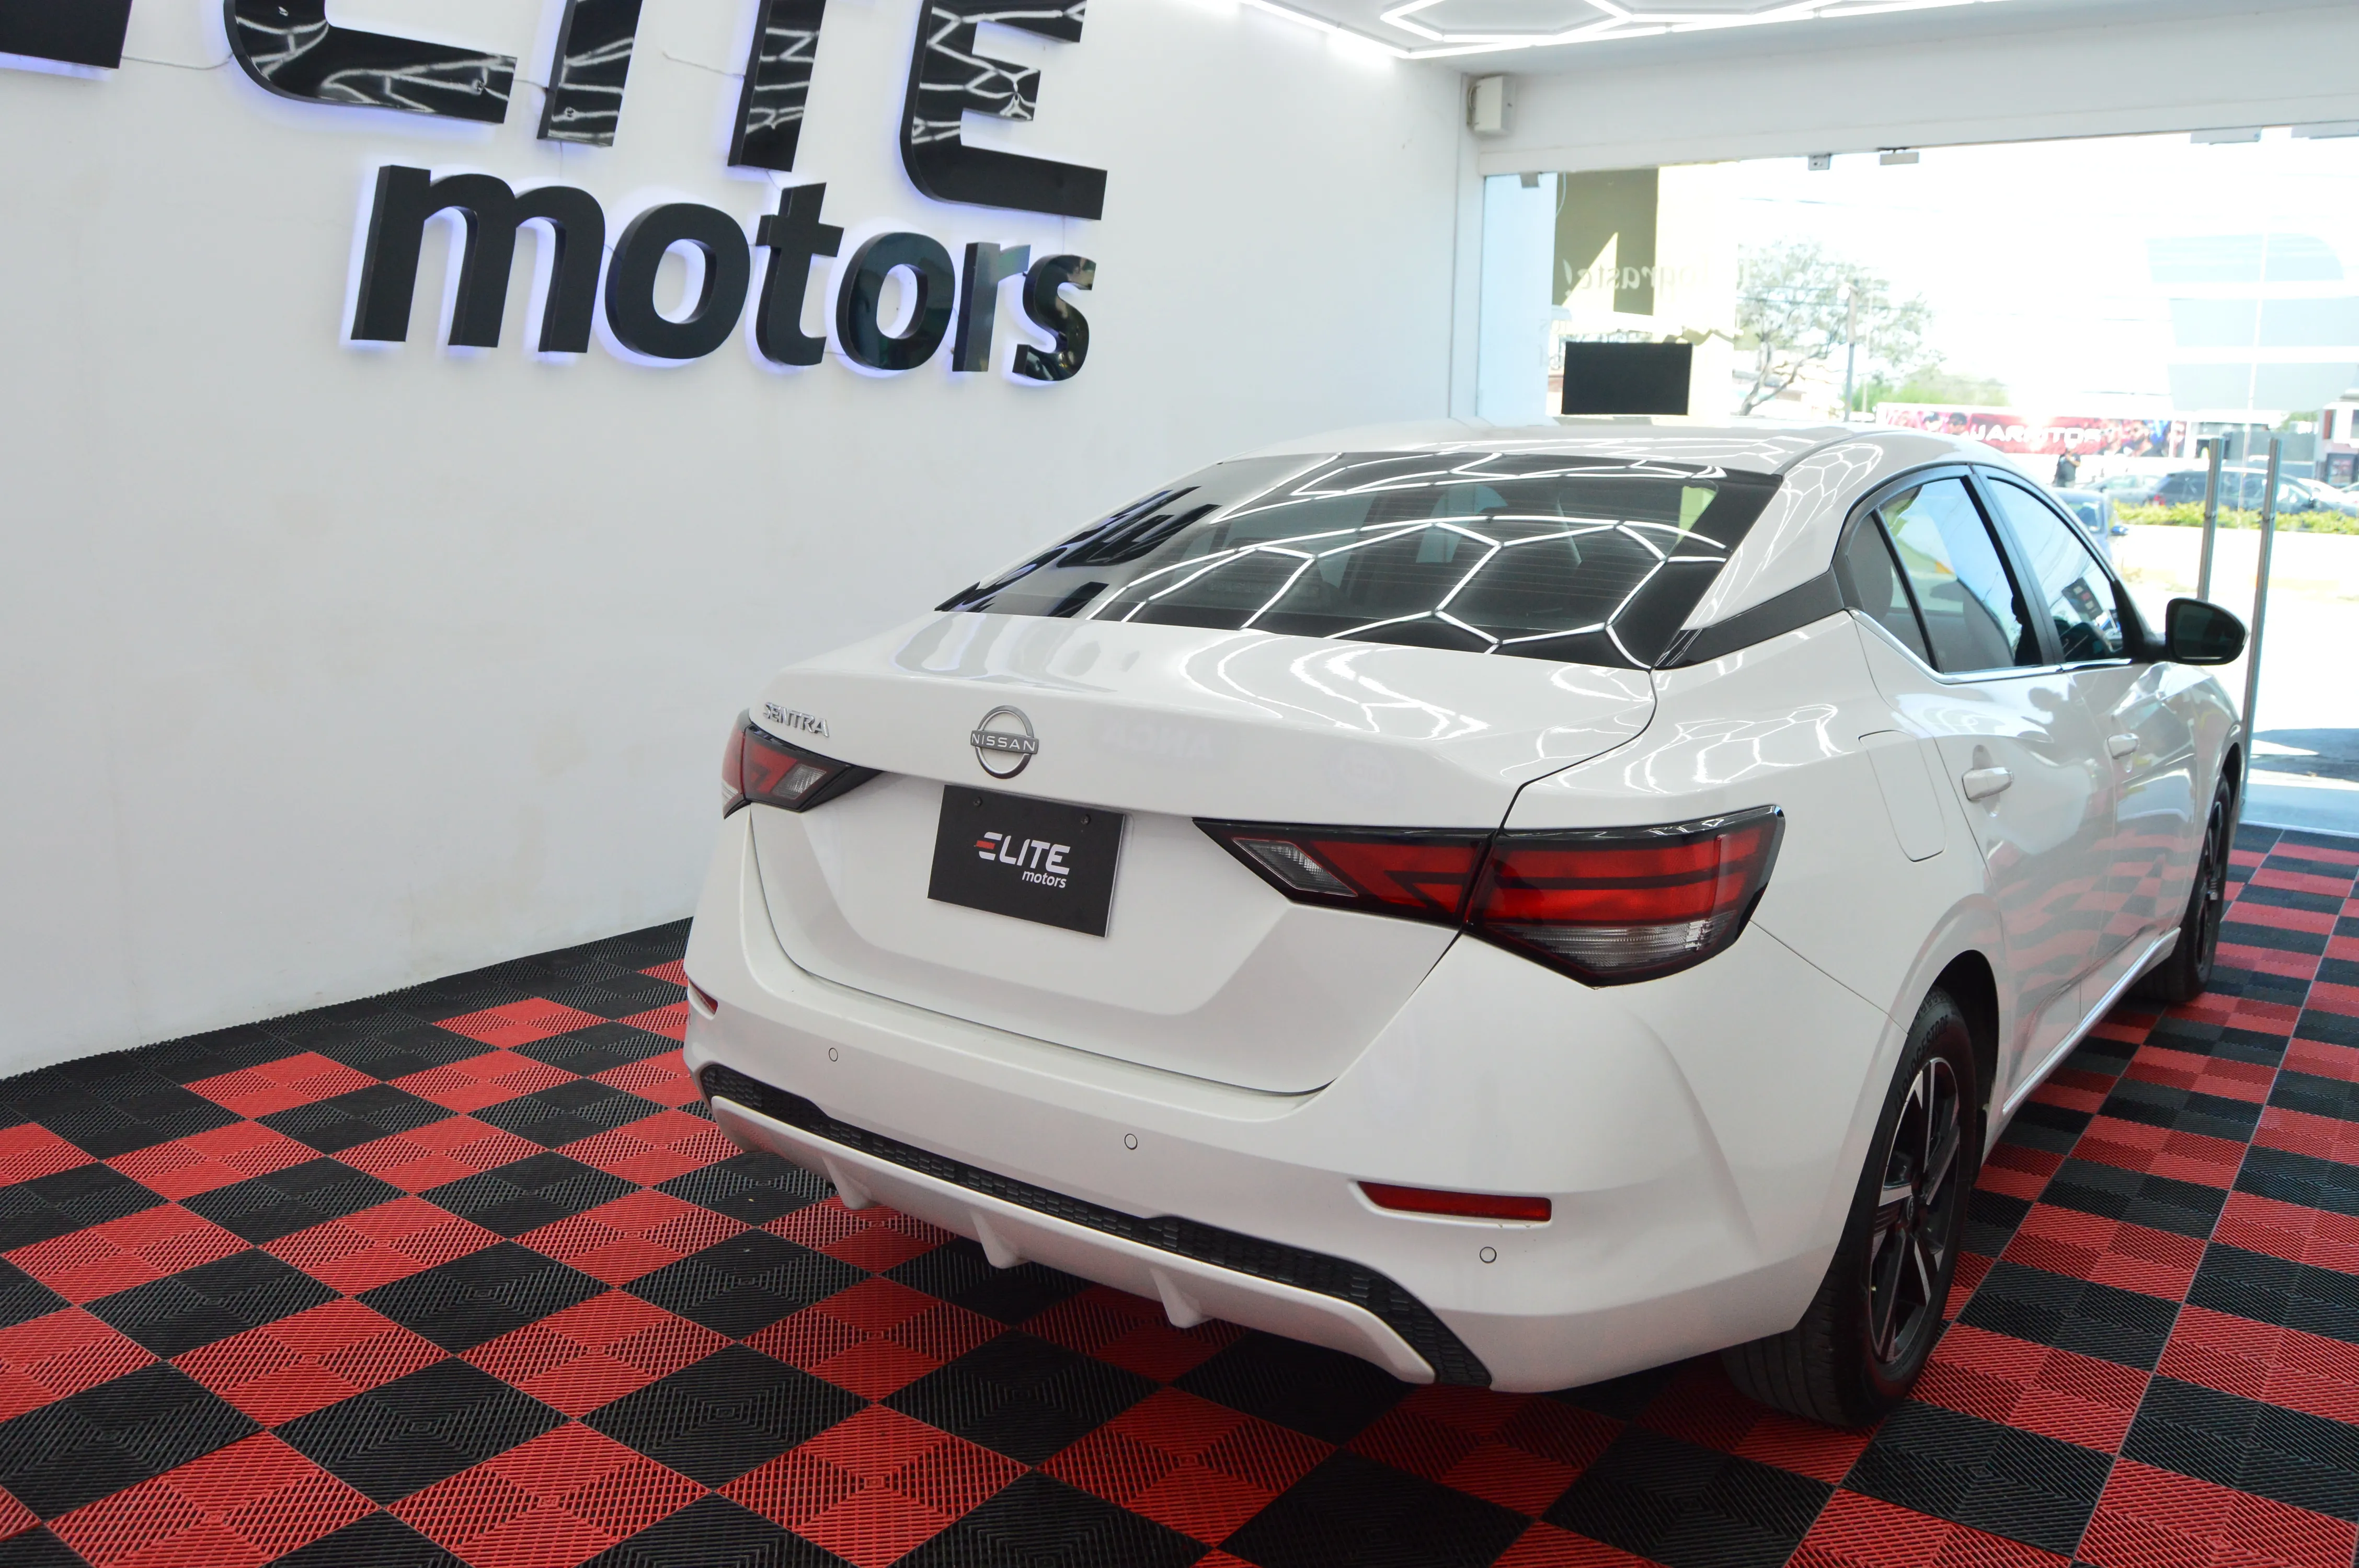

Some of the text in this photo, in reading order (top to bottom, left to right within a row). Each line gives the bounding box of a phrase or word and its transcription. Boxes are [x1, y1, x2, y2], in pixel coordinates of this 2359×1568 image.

[351, 165, 1096, 382] motors
[763, 701, 830, 737] SENTRA
[971, 733, 1035, 752] NISSAN
[976, 832, 1071, 875] ELITE
[1022, 871, 1067, 888] motors
